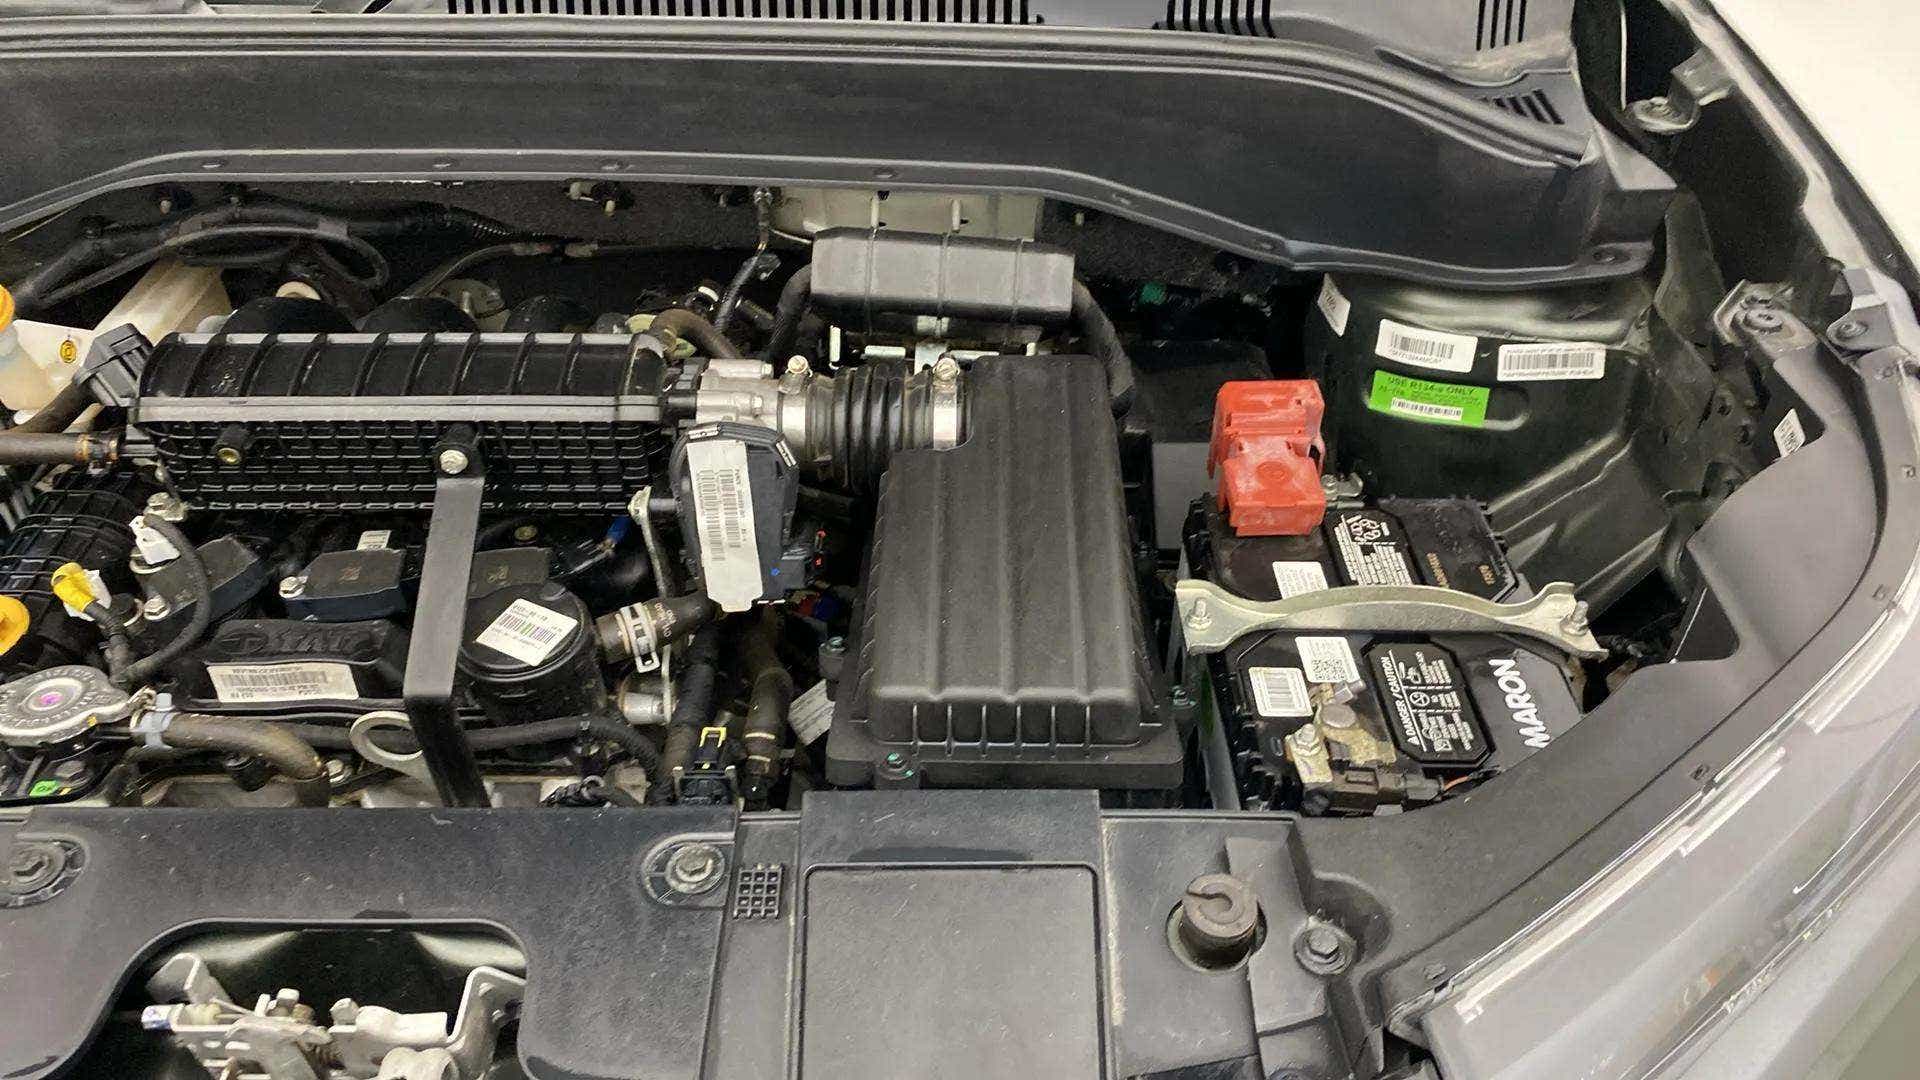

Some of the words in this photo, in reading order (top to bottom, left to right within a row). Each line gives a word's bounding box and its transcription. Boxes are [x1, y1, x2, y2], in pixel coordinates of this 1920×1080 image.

[1446, 385, 1477, 395] ONLY
[1380, 656, 1401, 693] CAUTION
[1395, 700, 1416, 736] DANGER
